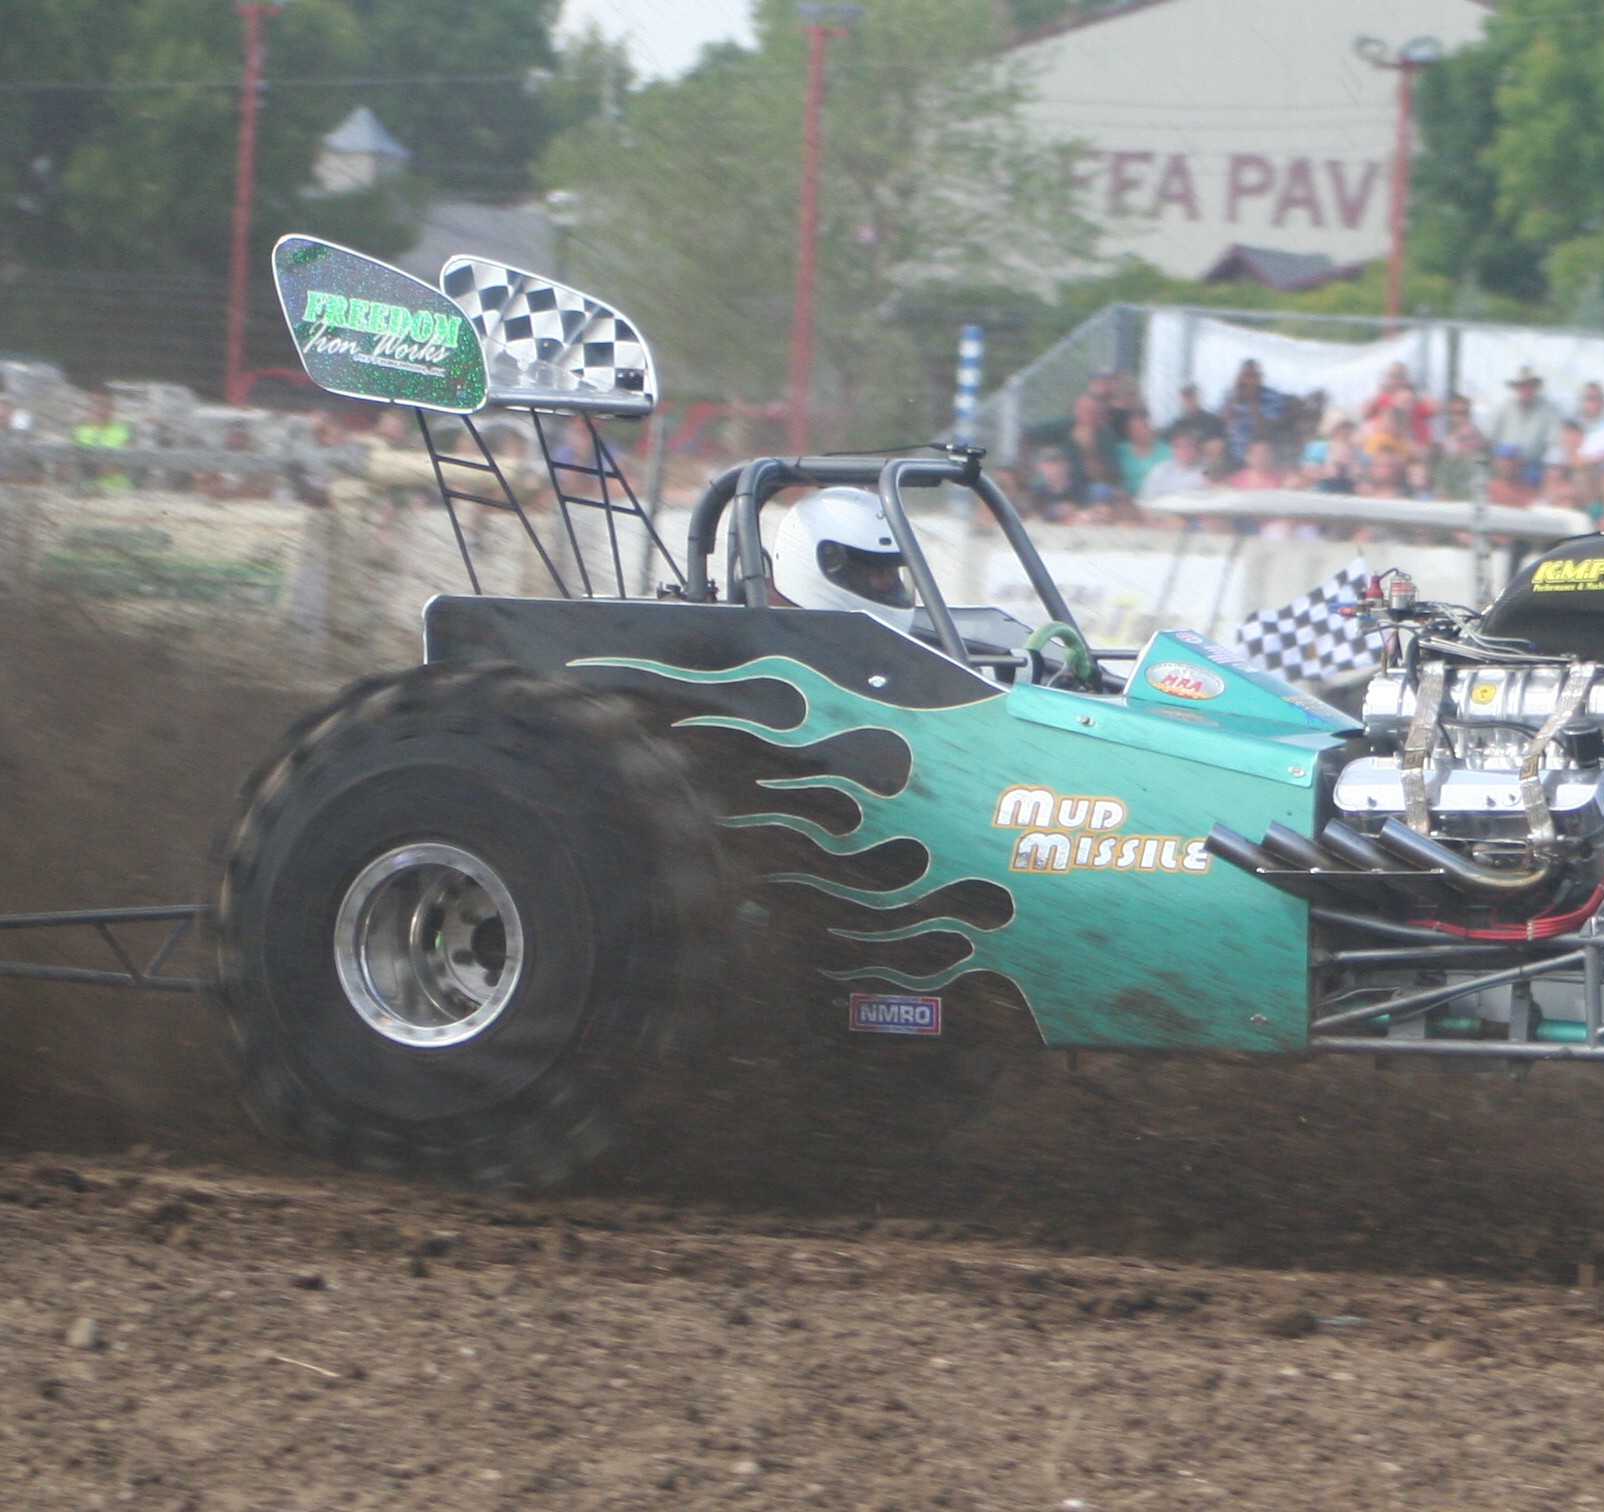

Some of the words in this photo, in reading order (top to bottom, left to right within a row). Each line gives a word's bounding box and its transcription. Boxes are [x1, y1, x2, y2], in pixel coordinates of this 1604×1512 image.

[302, 290, 462, 348] FREEDOM
[303, 321, 360, 355] Iron
[373, 331, 451, 363] Works
[994, 785, 1127, 830] MUD
[1010, 831, 1211, 874] MISSILE
[859, 1003, 931, 1025] NMRO
